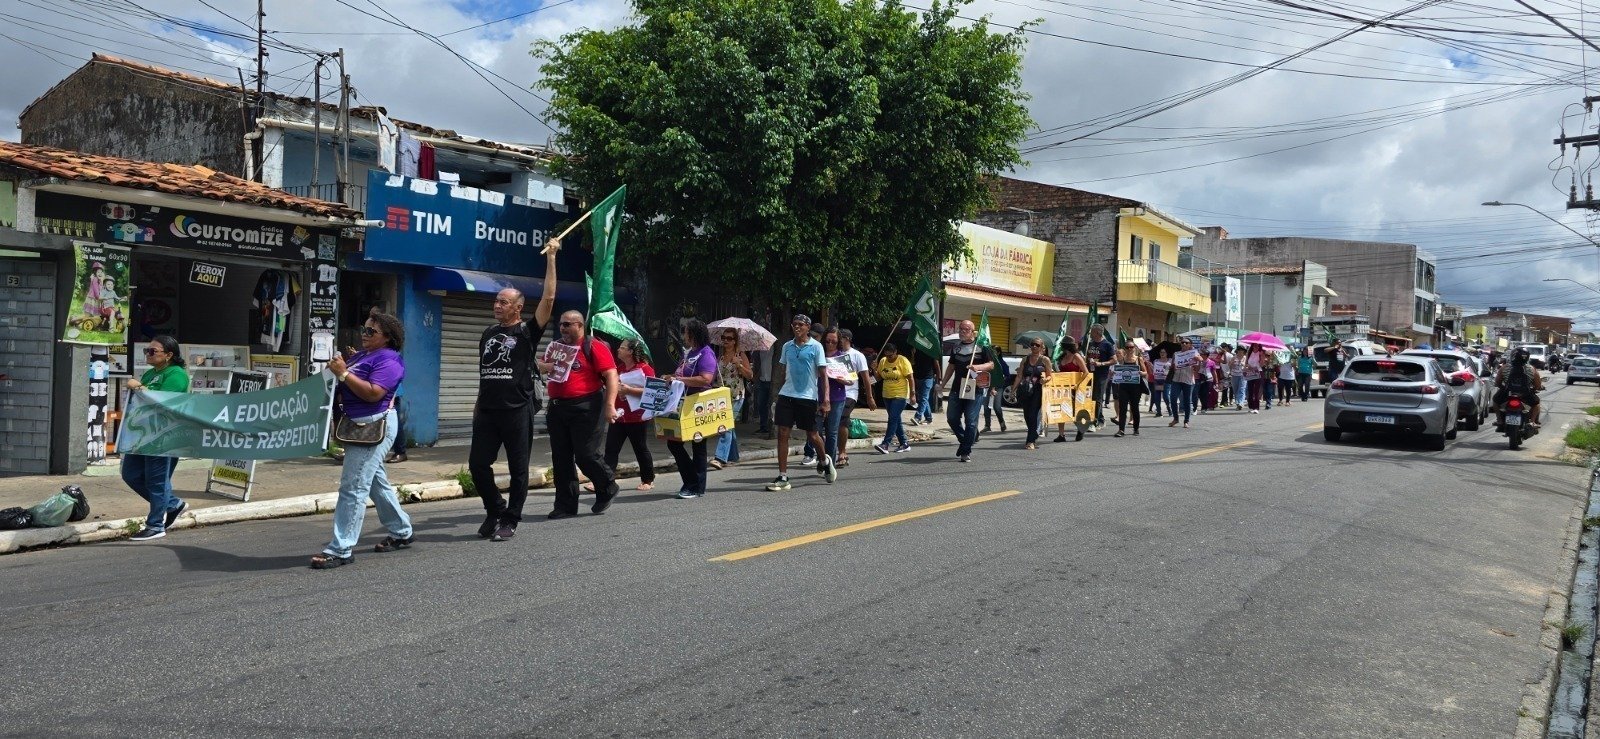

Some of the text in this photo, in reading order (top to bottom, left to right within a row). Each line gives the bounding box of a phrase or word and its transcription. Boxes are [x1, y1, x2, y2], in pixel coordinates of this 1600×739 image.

[413, 210, 452, 236] TIM
[187, 222, 284, 248] CUSTOMIZE
[475, 220, 527, 246] Bruna
[109, 253, 128, 262] 60x90
[982, 244, 999, 259] LOJA
[1000, 248, 1008, 260] DA
[1009, 247, 1033, 266] FÁBRICA
[194, 264, 224, 277] XEROX
[196, 273, 218, 285] AQUI
[551, 349, 567, 361] NÃO
[238, 380, 263, 393] XEROX
[212, 406, 230, 423] A
[235, 390, 309, 423] EDUCAÇÃO
[694, 411, 727, 427] ESCOLAR
[202, 428, 253, 449] EXIGE
[256, 422, 319, 449] RESPEITO!
